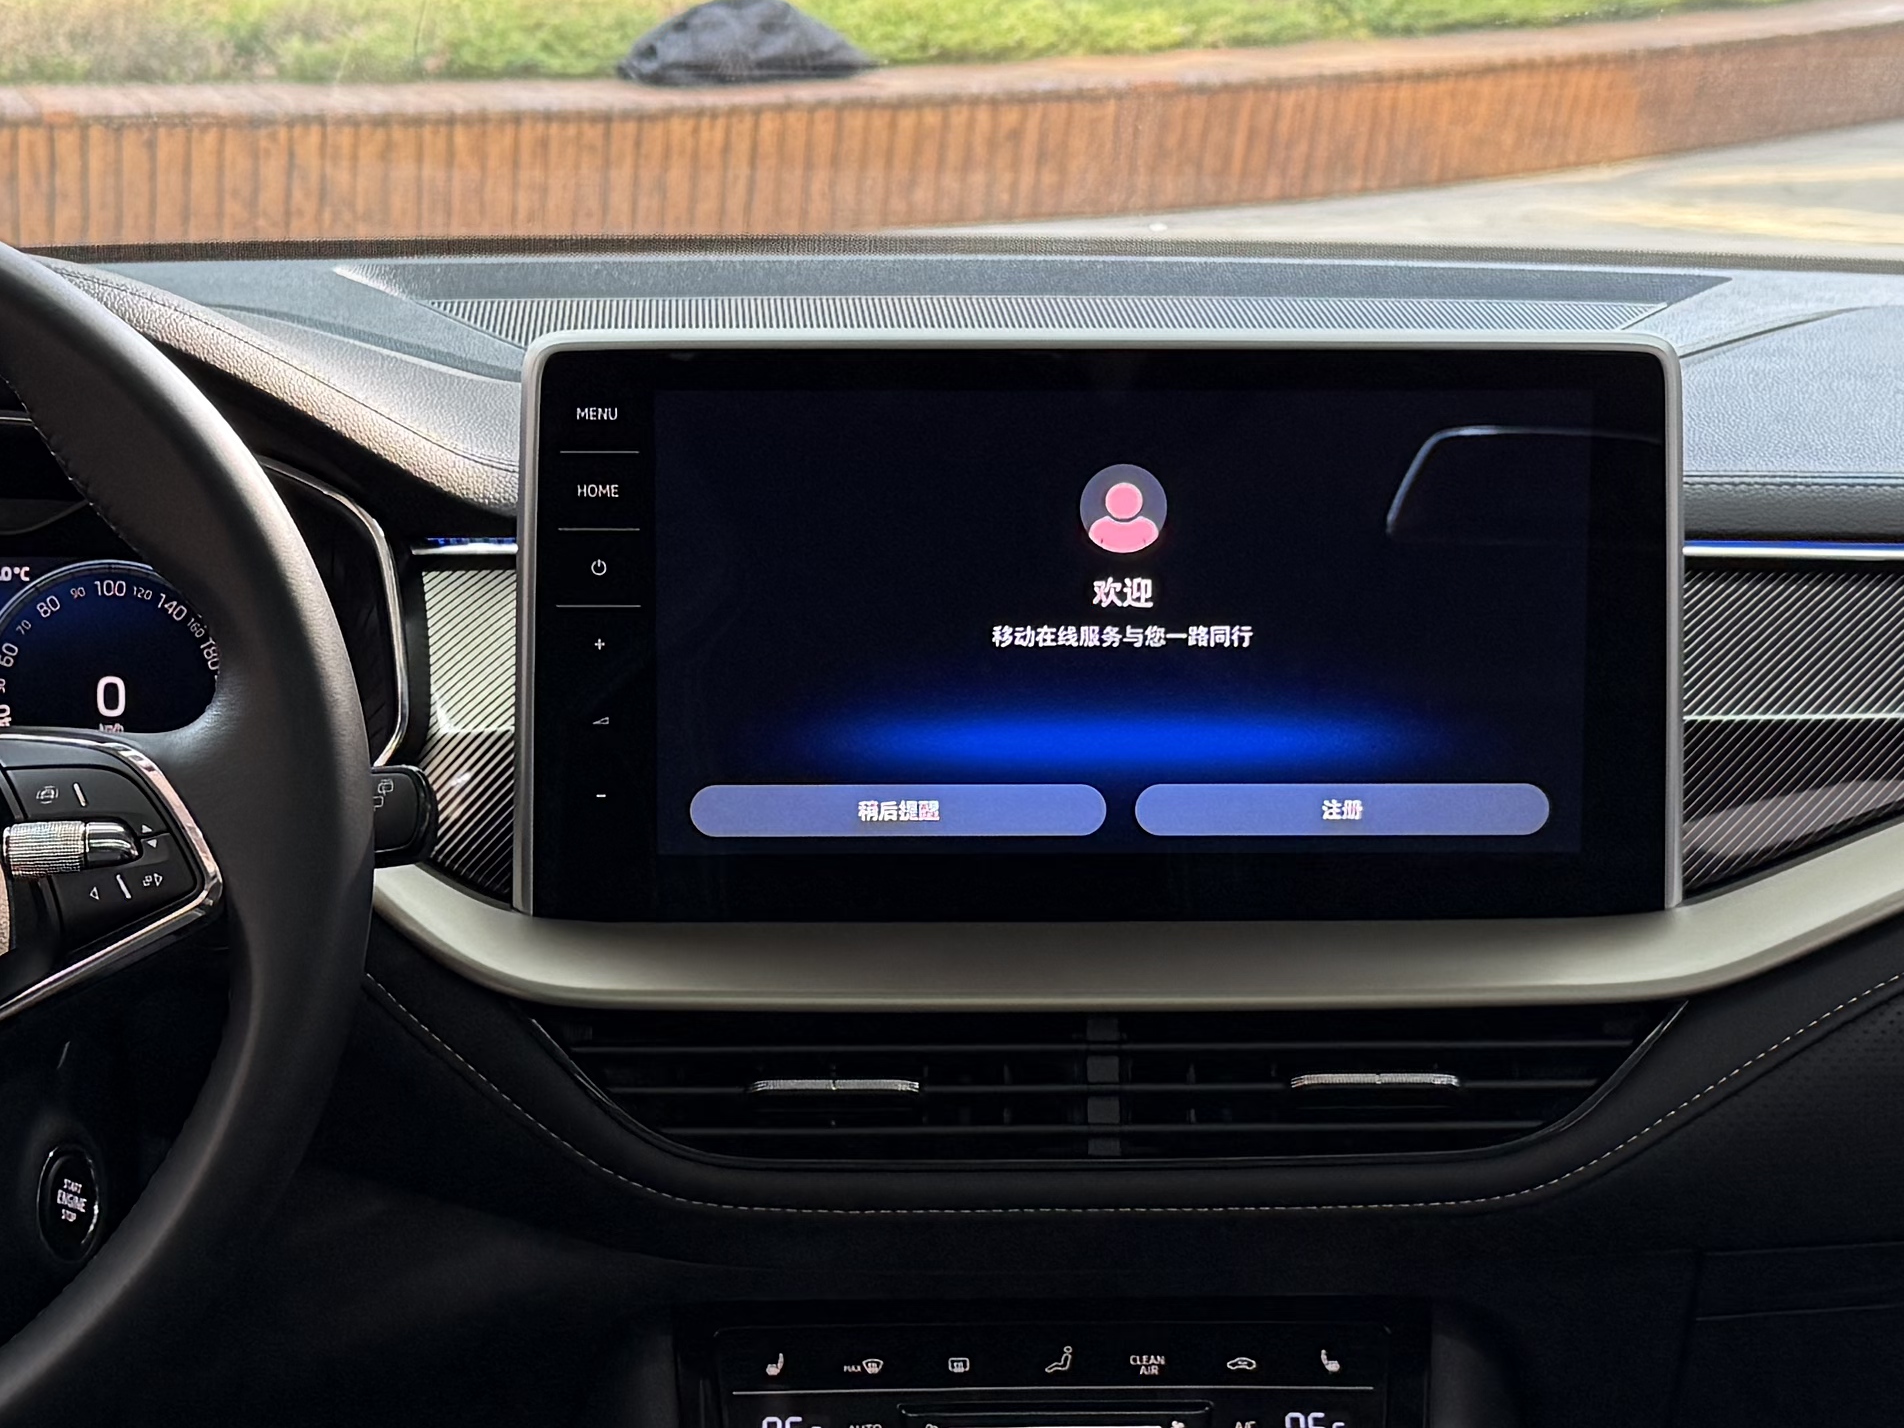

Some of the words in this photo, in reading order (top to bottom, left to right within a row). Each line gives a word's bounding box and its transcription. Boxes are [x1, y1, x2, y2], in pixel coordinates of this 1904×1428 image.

[577, 408, 617, 420] MENU
[578, 484, 618, 497] HOME
[70, 587, 85, 598] 90
[95, 580, 126, 596] 100
[132, 586, 153, 601] 120
[1093, 577, 1153, 608] 欢迎
[37, 596, 60, 617] 80
[157, 593, 188, 621] 140
[15, 619, 32, 635] 70
[187, 617, 205, 638] 160
[992, 625, 1253, 647] 移动在线服务与您一路同行
[97, 676, 125, 717] 0
[858, 800, 940, 821] 稍后提醒
[1322, 799, 1363, 820] 注册
[63, 1178, 82, 1193] START
[56, 1189, 87, 1213] ENGINE
[61, 1209, 77, 1222] STOP
[843, 1364, 861, 1373] MAX
[1129, 1355, 1166, 1366] CLEAN
[1139, 1365, 1159, 1375] AIR
